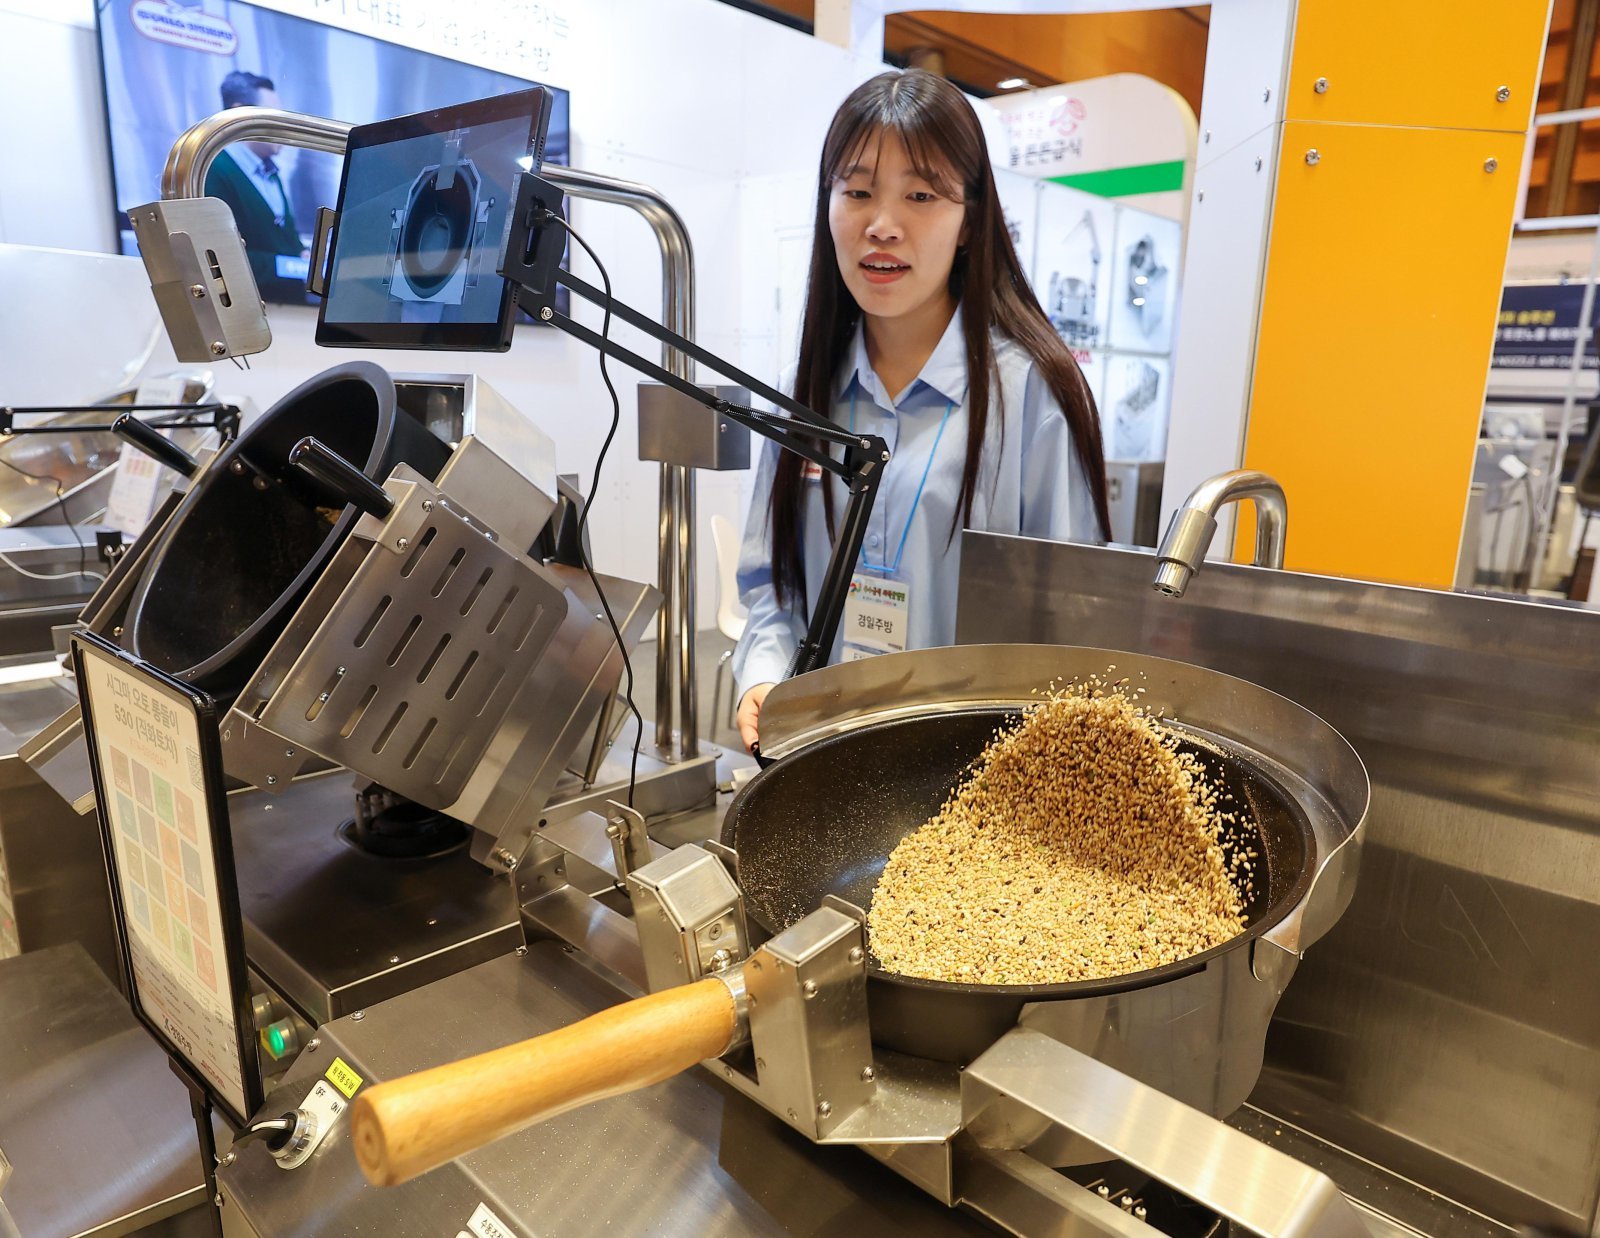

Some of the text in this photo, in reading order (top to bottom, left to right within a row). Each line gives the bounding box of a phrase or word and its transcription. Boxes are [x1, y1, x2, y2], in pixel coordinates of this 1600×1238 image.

[857, 614, 893, 634] 경일주방
[106, 672, 180, 736] 시그마 오토 통돌이
[114, 703, 134, 731] 530
[315, 1086, 326, 1097] OFF
